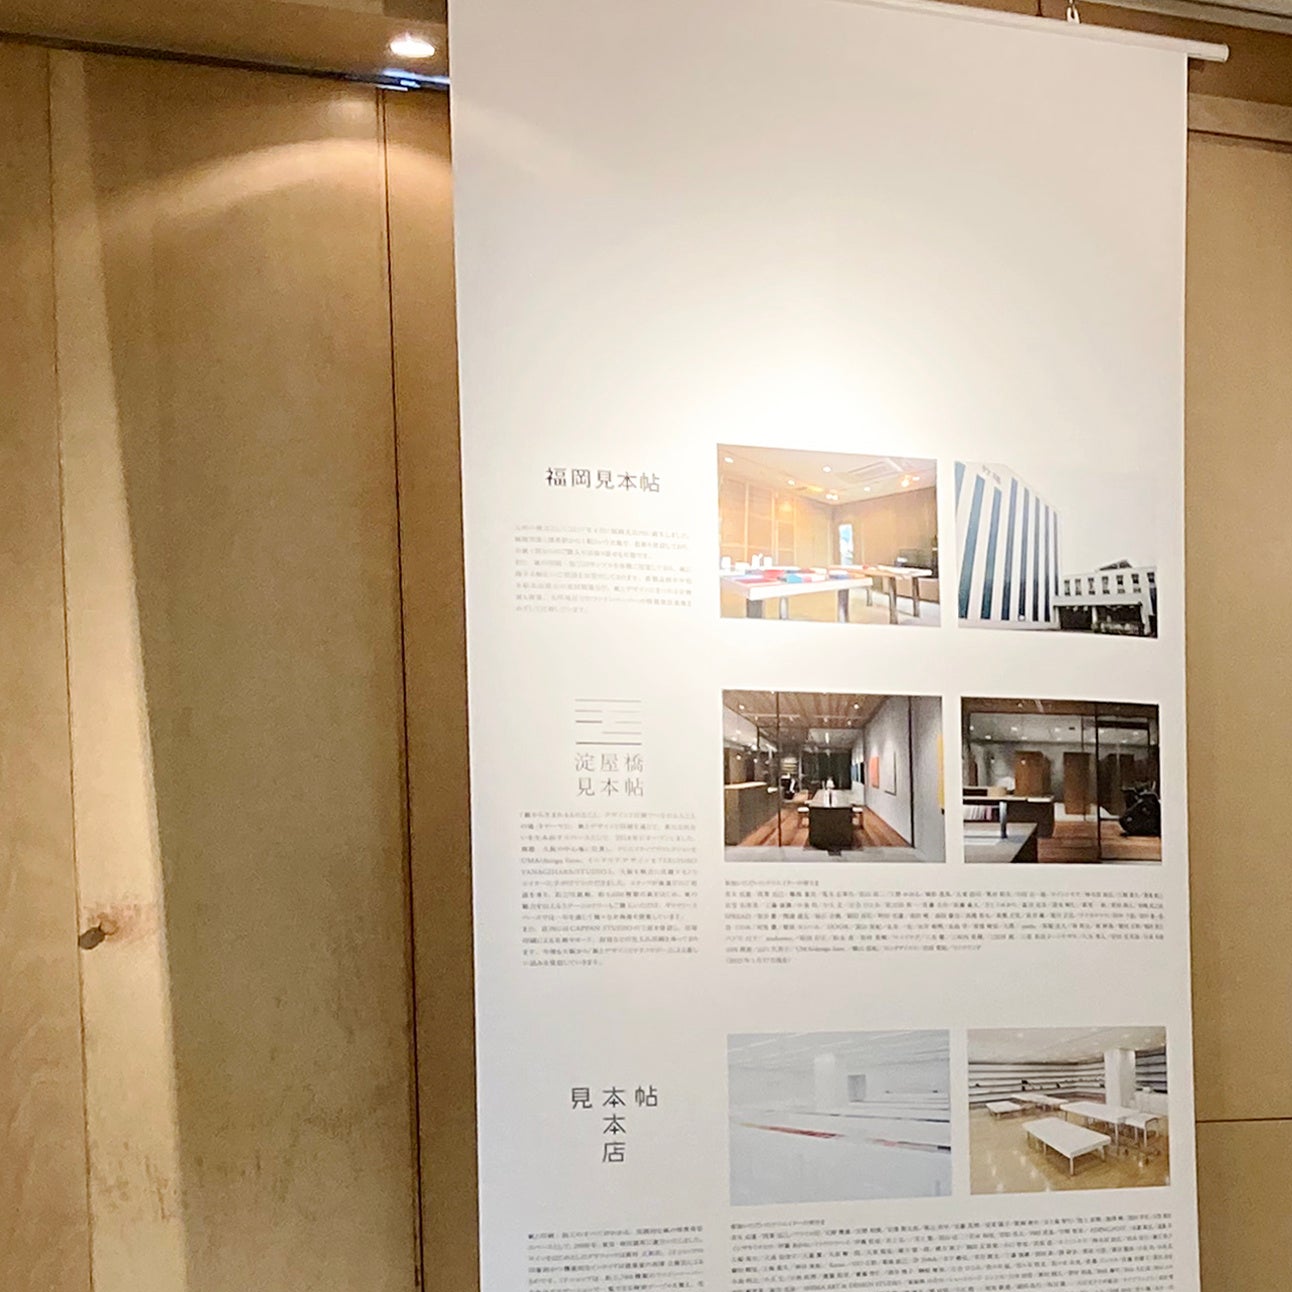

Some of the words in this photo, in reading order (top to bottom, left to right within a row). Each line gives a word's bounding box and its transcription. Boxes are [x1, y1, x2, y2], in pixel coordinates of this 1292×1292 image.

[545, 466, 660, 493] 福岡見本帖
[573, 751, 645, 773] 淀屋橋
[575, 776, 645, 798] 見本帖
[570, 1085, 658, 1110] 見本帖
[602, 1113, 627, 1163] 本店
